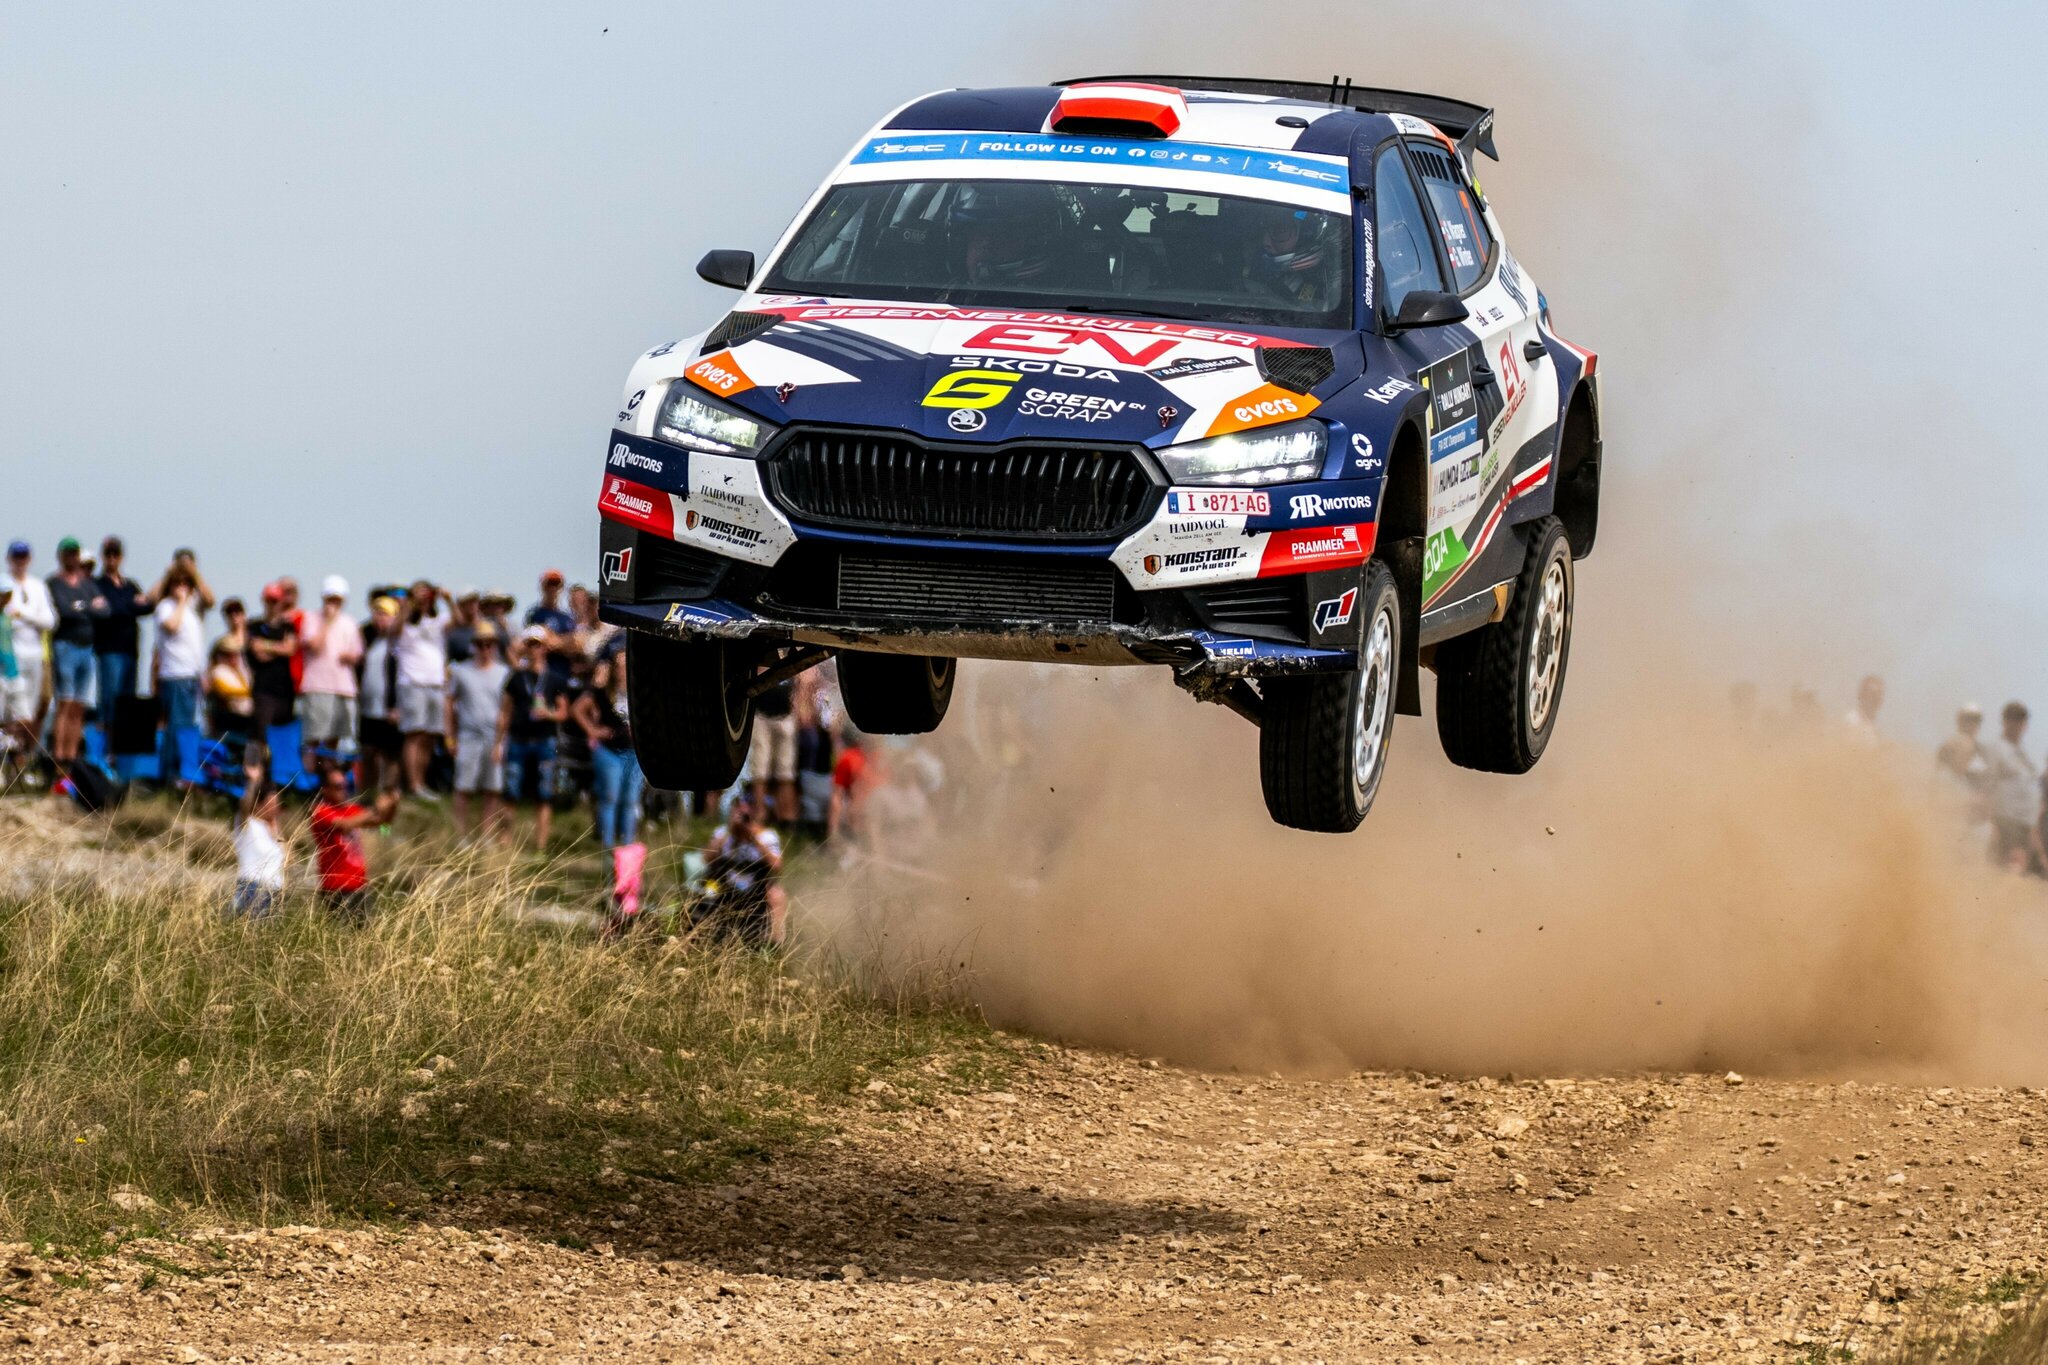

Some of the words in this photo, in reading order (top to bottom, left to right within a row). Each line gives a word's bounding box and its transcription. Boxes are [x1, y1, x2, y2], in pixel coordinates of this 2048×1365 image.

[979, 142, 1056, 153] FOLLOW
[1060, 144, 1085, 154] US
[1090, 146, 1117, 156] ON
[1363, 218, 1376, 309] simon-wagner.com
[694, 361, 739, 389] evers
[1161, 365, 1193, 376] RALLY
[1193, 358, 1240, 370] HUNGARY
[1025, 388, 1127, 413] GREEN
[1017, 400, 1112, 423] SCRAP
[1234, 398, 1298, 422] evers
[626, 452, 663, 473] MOTORS
[1355, 459, 1382, 470] agru
[614, 491, 653, 514] PRAMMER
[700, 485, 746, 507] HAIDVOGL
[1322, 496, 1372, 511] MOTORS
[1169, 519, 1228, 534] HAIDVOGL
[709, 531, 756, 548] workwear
[1291, 538, 1345, 555] PRAMMER
[1180, 560, 1237, 573] workwear
[1220, 647, 1252, 655] HELIN
